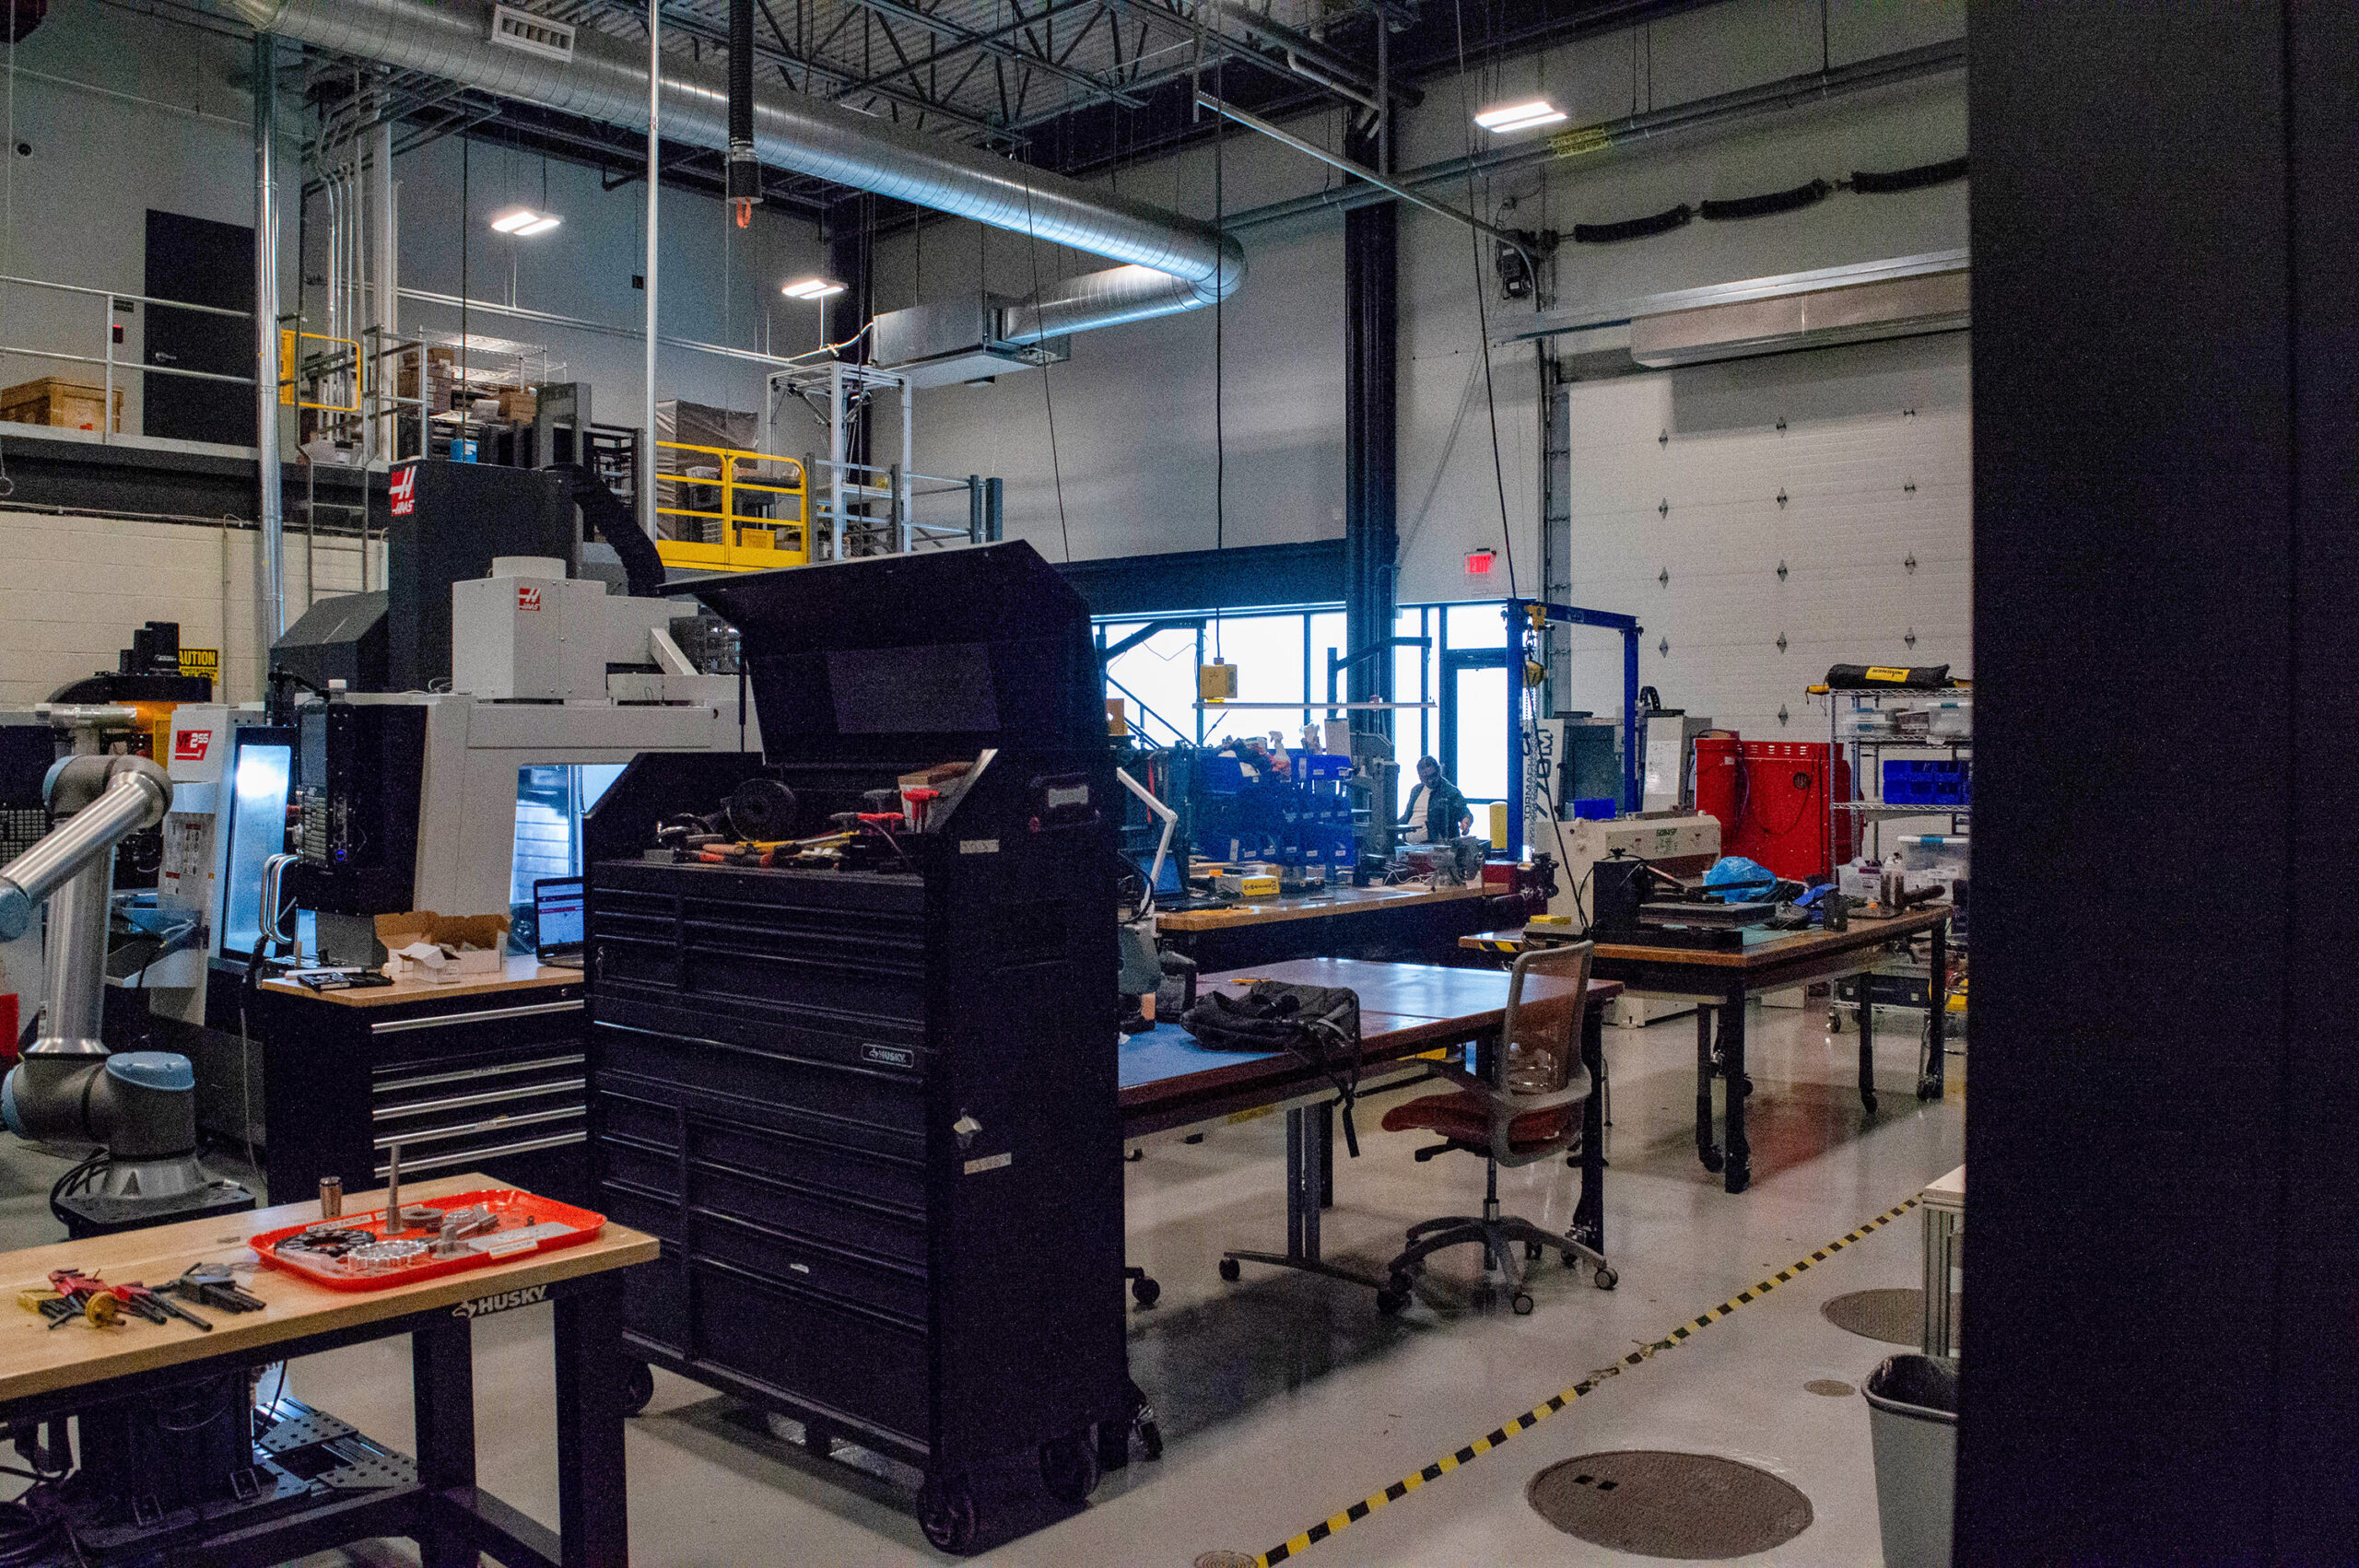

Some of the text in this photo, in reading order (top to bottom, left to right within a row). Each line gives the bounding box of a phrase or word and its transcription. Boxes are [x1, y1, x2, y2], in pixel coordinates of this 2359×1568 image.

[179, 649, 217, 666] AUTION
[878, 1048, 907, 1063] HUSKY
[477, 1284, 547, 1315] HUSKY
